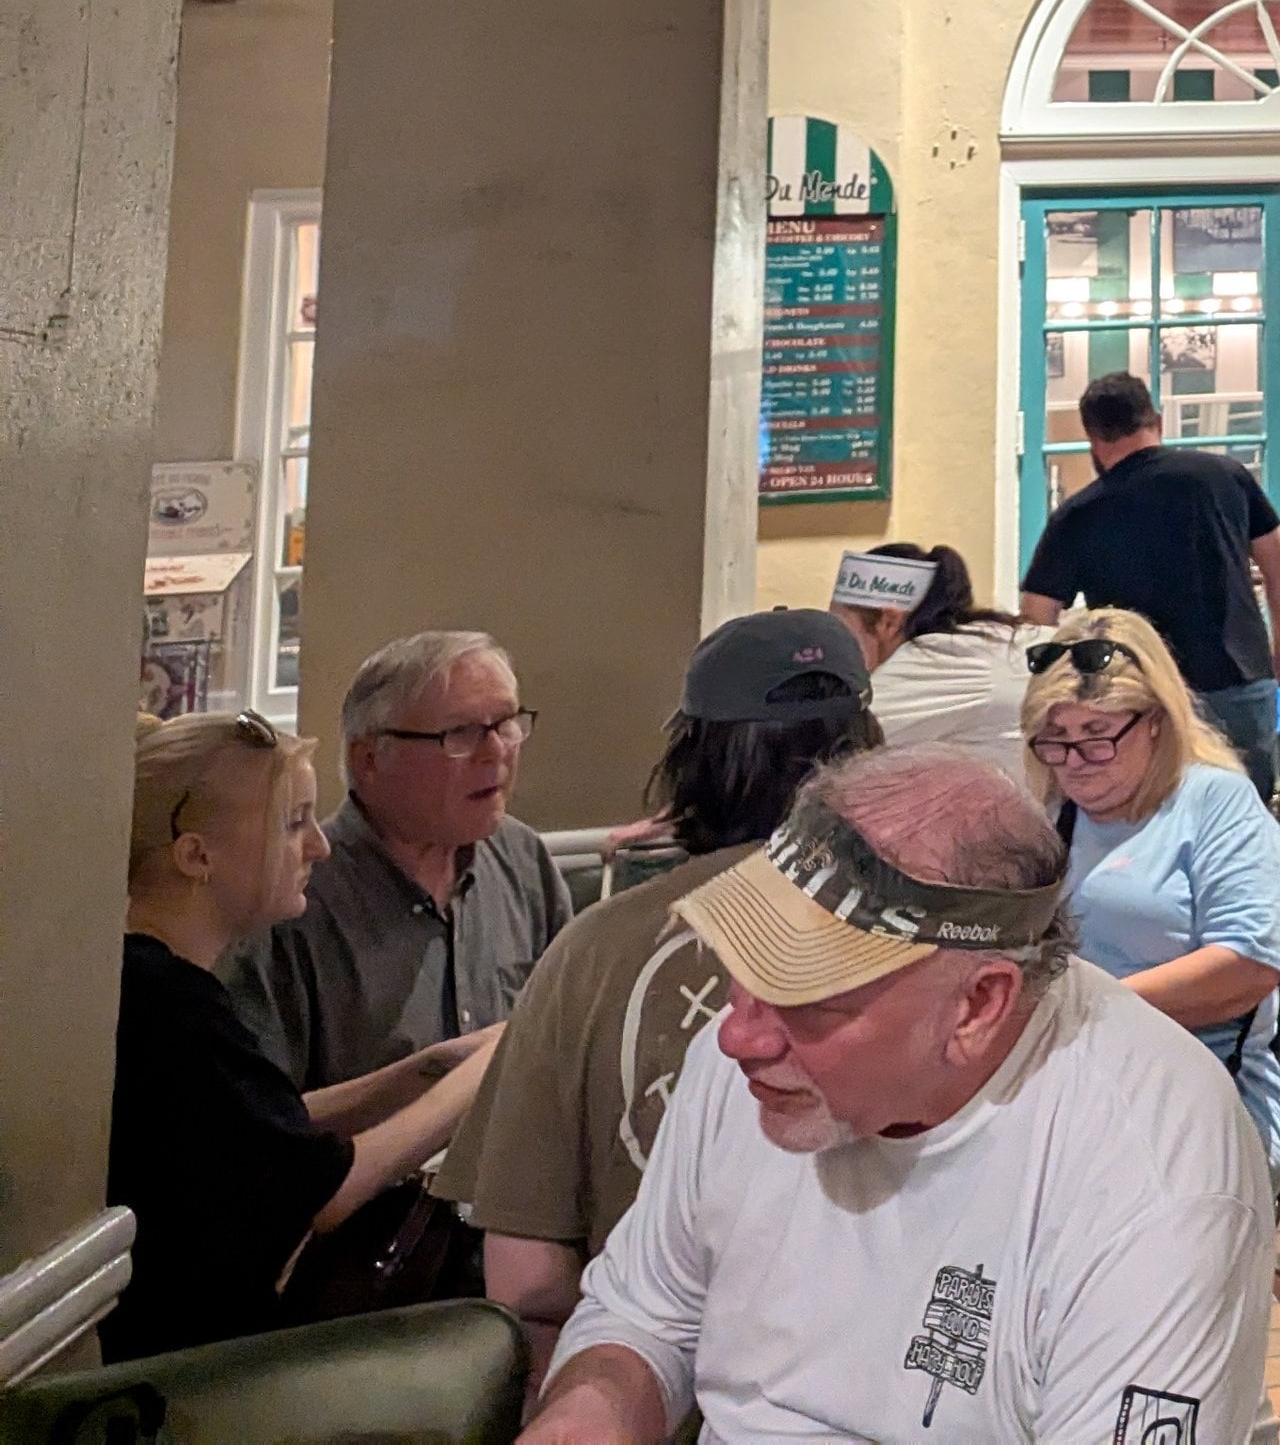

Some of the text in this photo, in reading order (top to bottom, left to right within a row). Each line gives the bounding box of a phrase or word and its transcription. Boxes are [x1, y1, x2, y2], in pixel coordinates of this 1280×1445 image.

[766, 169, 869, 204] Du Monde
[848, 572, 867, 590] Du
[937, 921, 1001, 943] Reebok
[937, 1273, 996, 1314] PARADIS
